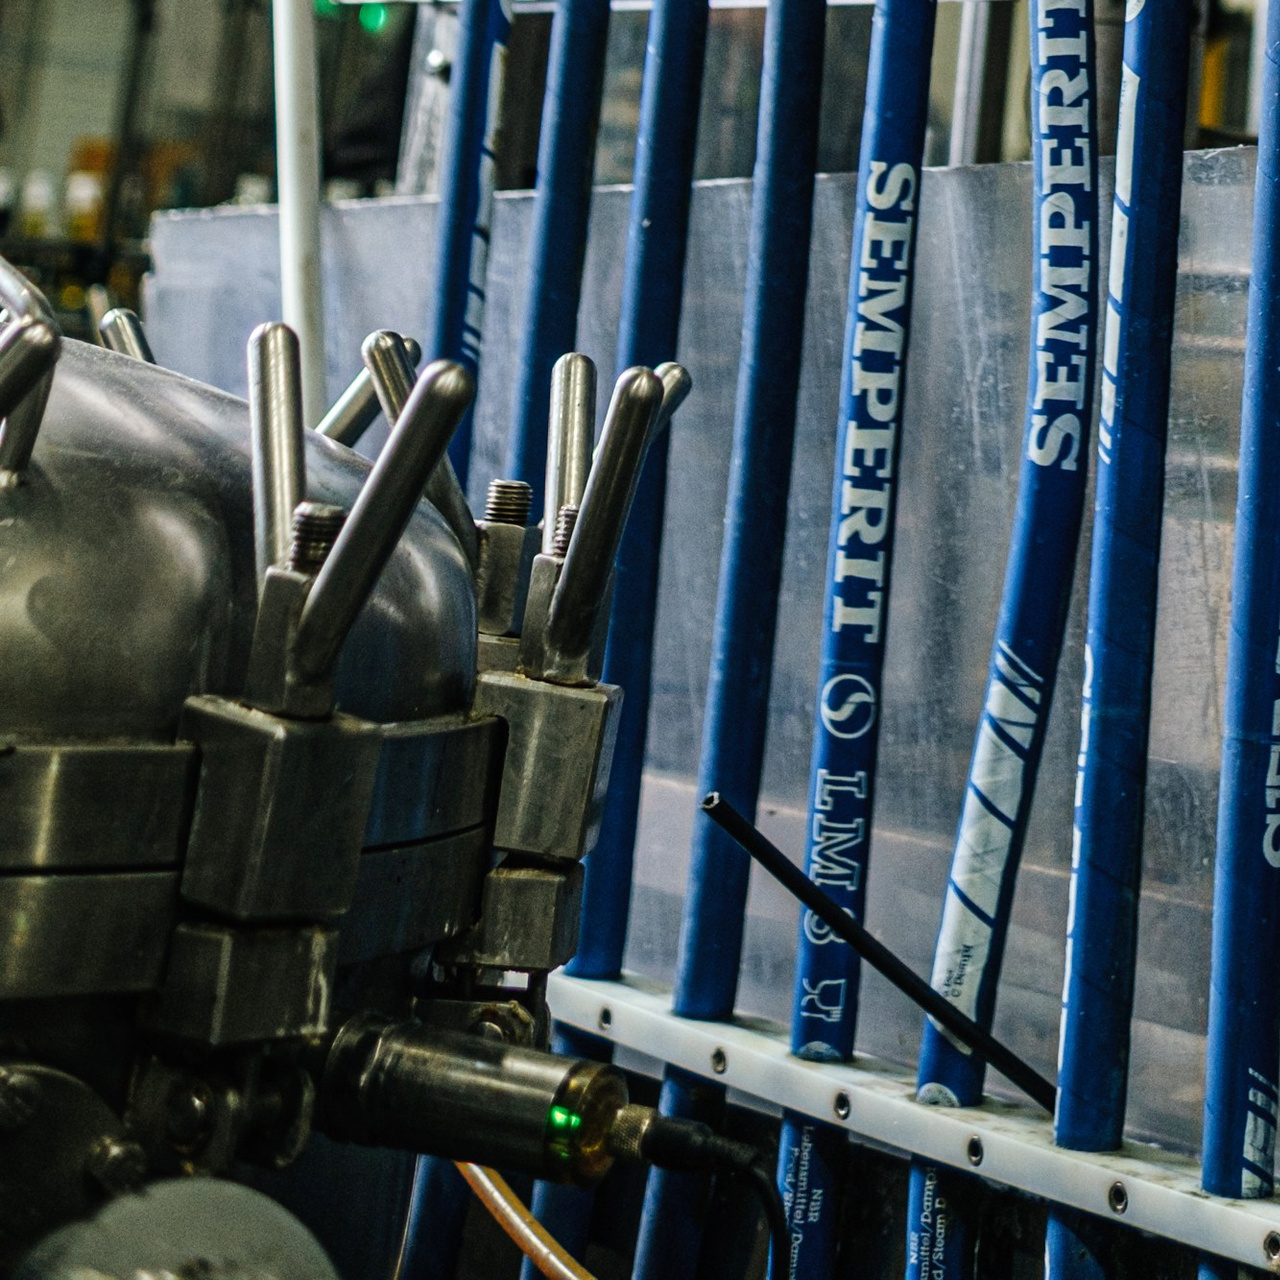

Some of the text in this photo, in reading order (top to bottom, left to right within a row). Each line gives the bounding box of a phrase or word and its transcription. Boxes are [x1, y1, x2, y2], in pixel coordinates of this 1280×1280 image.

[831, 160, 915, 643] SEMPERIT
[810, 769, 868, 890] LM
[807, 1188, 824, 1223] NBR
[909, 1231, 919, 1264] NBR
